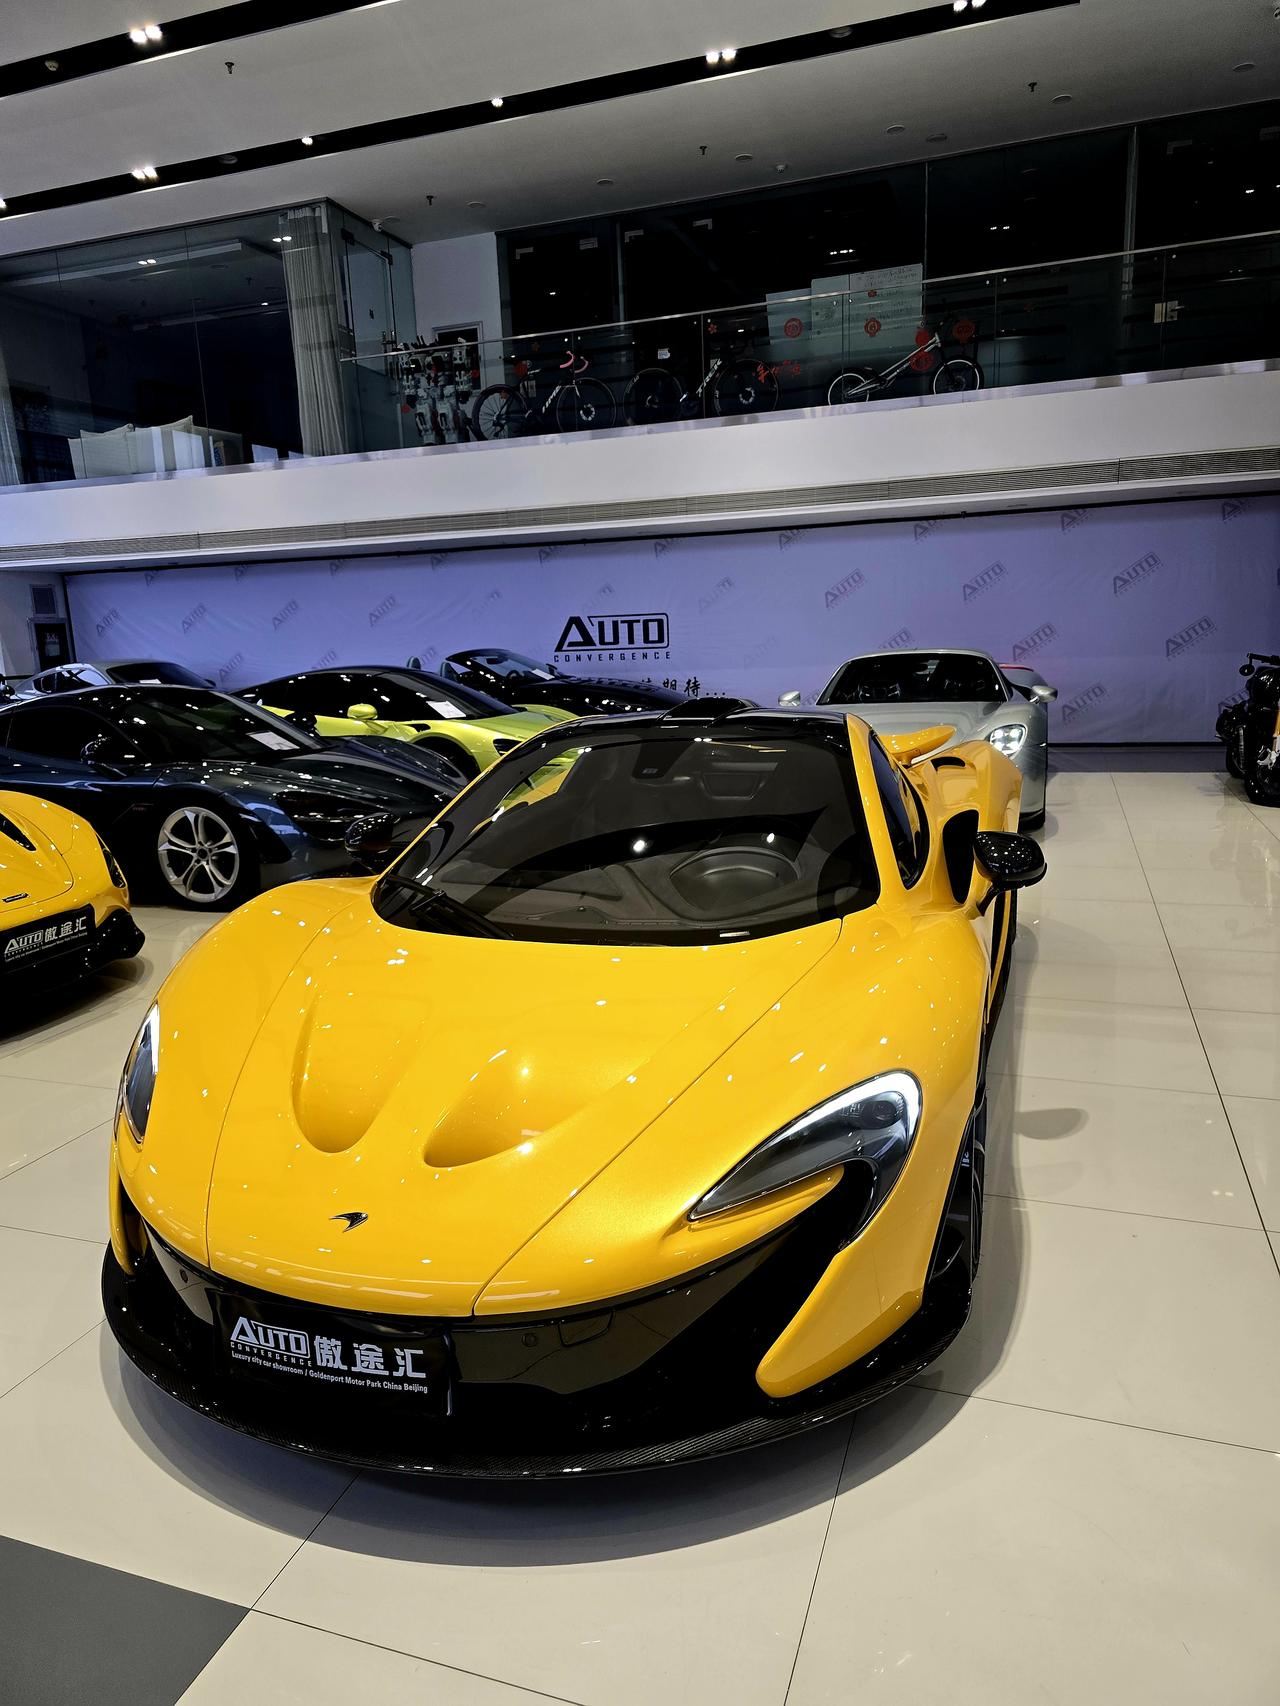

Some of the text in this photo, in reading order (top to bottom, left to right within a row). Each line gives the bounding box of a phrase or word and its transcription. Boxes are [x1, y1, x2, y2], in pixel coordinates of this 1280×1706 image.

[824, 569, 865, 608] AUTO
[962, 561, 1007, 601] AUTO
[1113, 552, 1161, 593] AUTO
[554, 613, 668, 652] AUTO
[1012, 622, 1057, 661] AUTO
[1166, 616, 1215, 657] AUTO
[554, 651, 670, 663] CONVERGENCE
[1062, 683, 1107, 722] AUTO
[5, 930, 43, 953] AUTO
[230, 1316, 309, 1357] AUTO
[230, 1341, 312, 1367] CONVERGENCE
[231, 1351, 251, 1363] Luxury
[251, 1356, 262, 1365] city
[272, 1362, 304, 1375] showroom
[308, 1369, 344, 1383] Goldenport
[345, 1376, 365, 1386] Motor
[366, 1379, 382, 1388] Park
[382, 1381, 402, 1390] China
[403, 1383, 428, 1394] Beijing
[314, 1335, 426, 1378] 傲途汇
